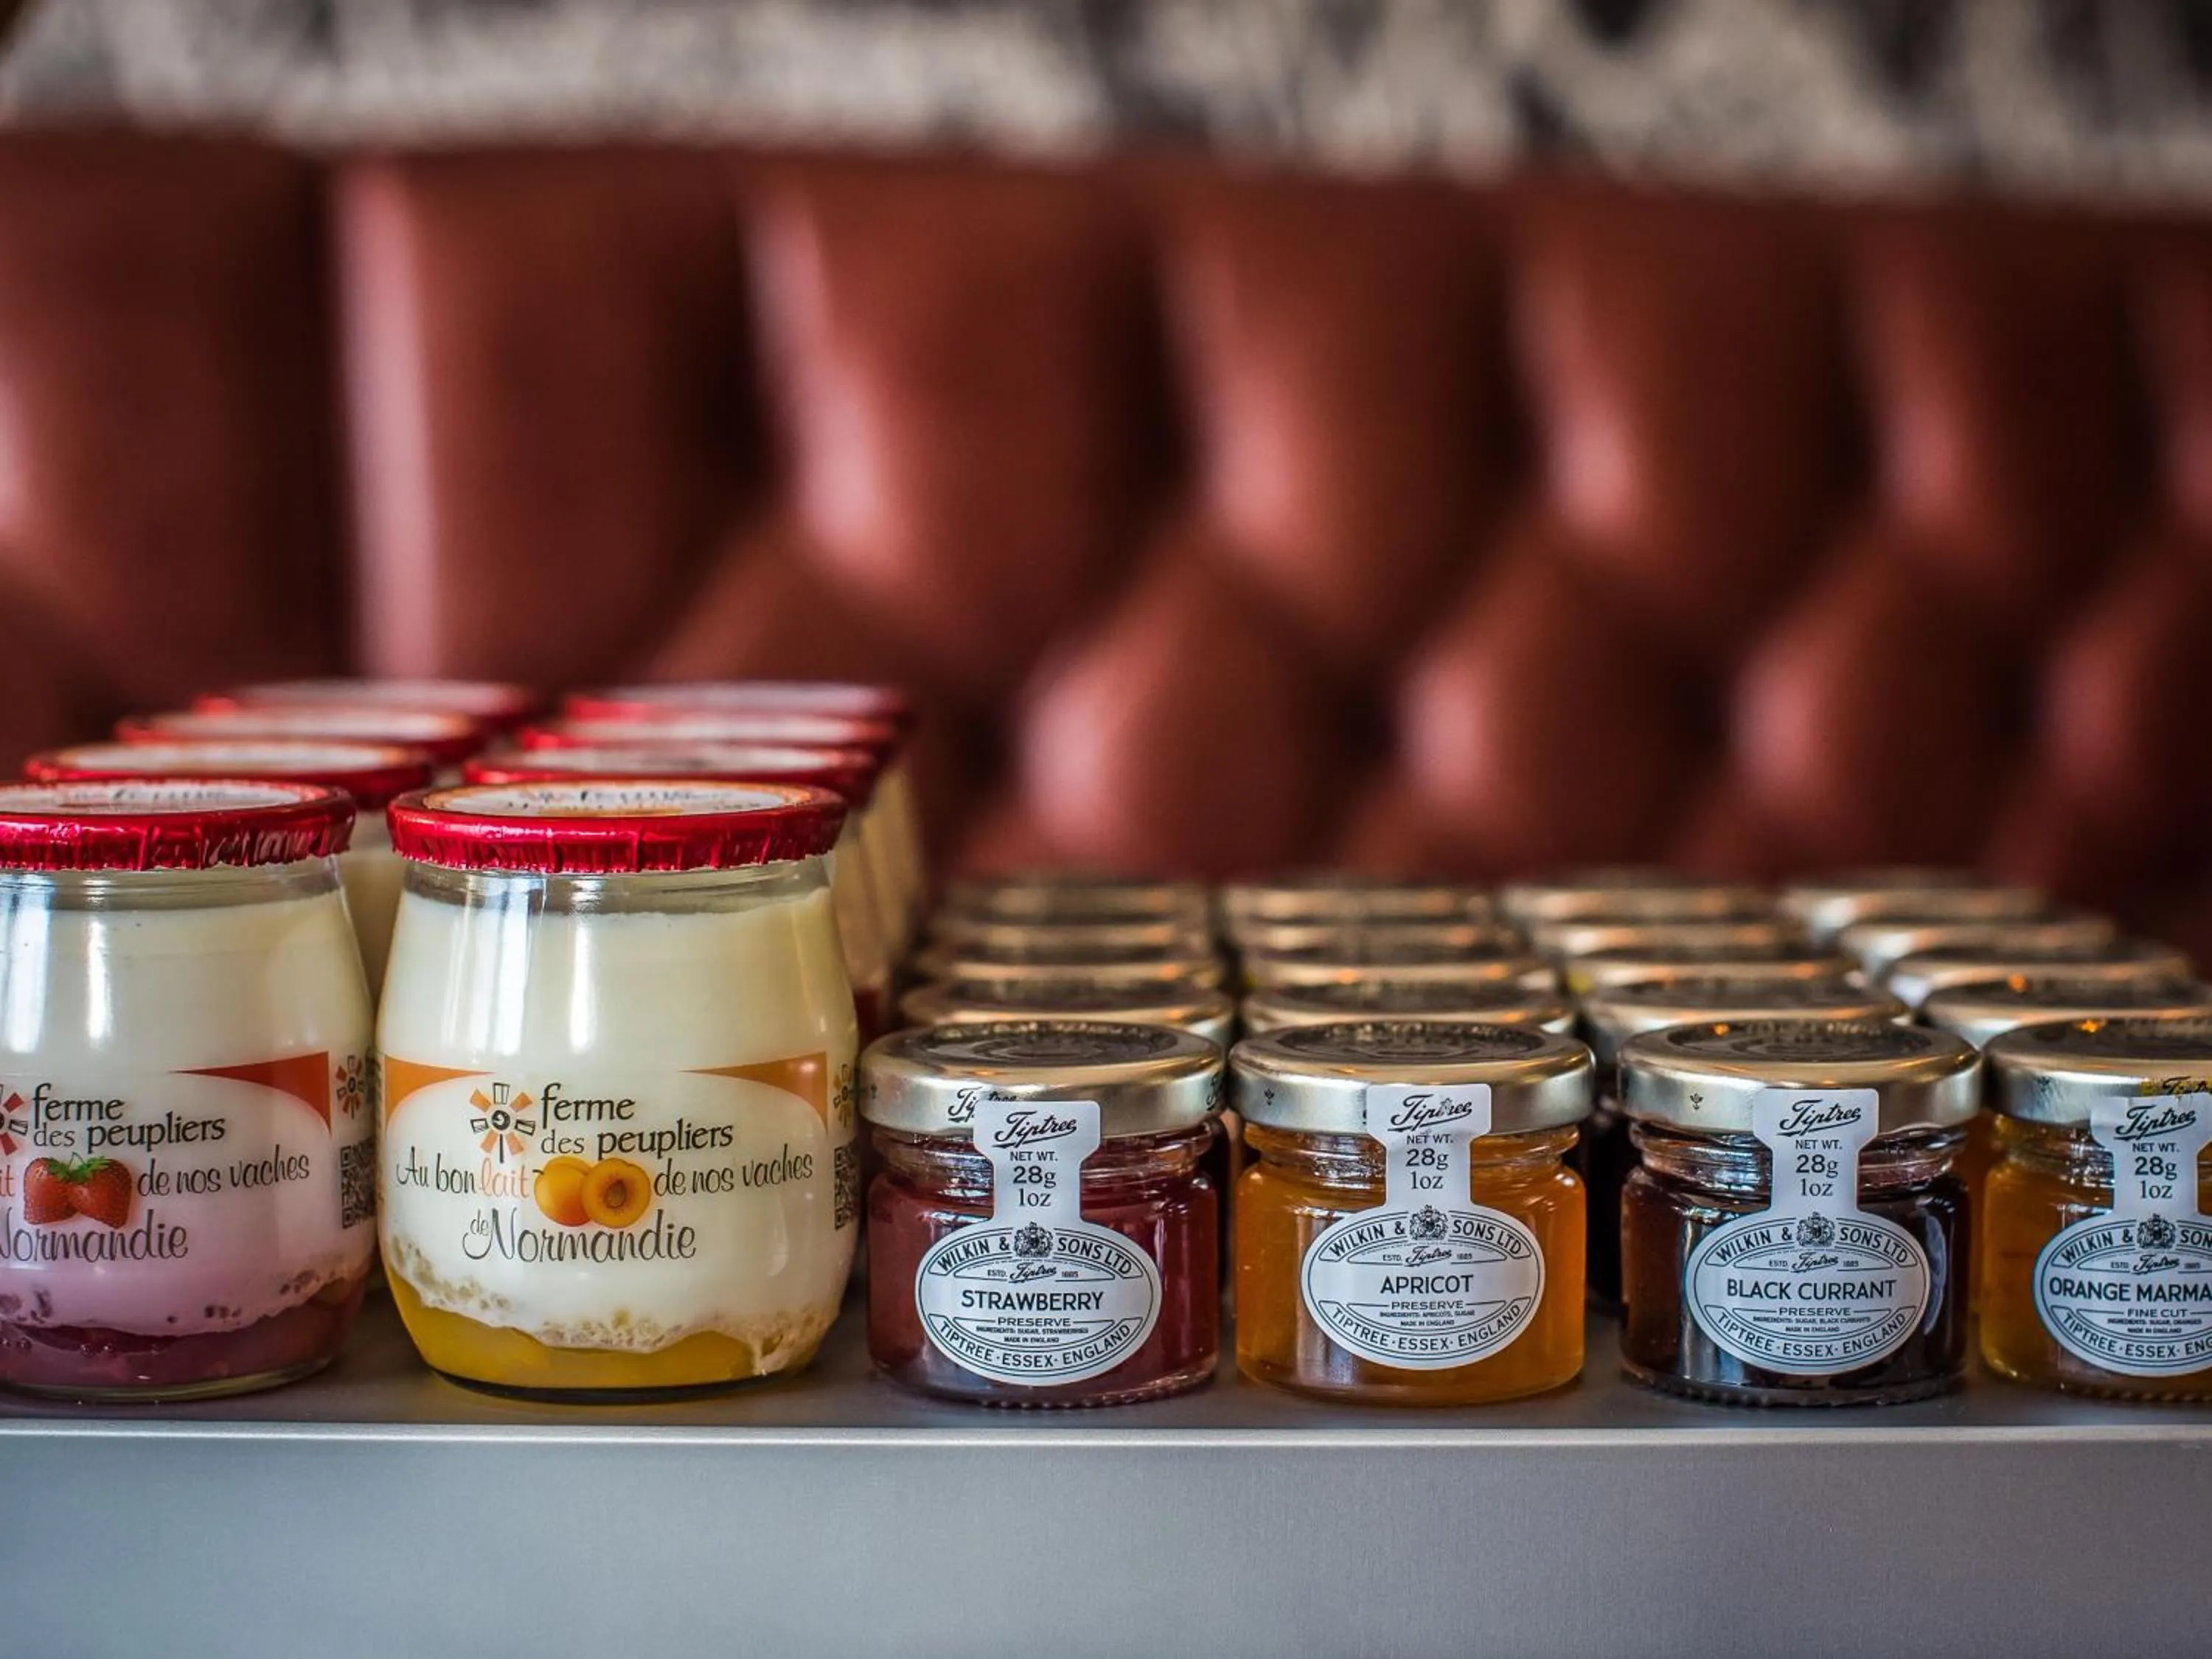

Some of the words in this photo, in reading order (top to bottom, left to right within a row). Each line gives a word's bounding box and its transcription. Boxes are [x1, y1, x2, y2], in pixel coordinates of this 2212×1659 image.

[32, 1082, 125, 1129] ferme
[540, 1082, 636, 1130] ferme
[1776, 1098, 1862, 1137] Tiptree
[33, 1122, 76, 1147] des
[87, 1110, 226, 1153] peupliers
[992, 1110, 1077, 1149] Tiptree
[2113, 1105, 2197, 1141] Tiptree
[540, 1129, 585, 1154] des
[597, 1118, 734, 1160] peupliers
[1406, 1134, 1428, 1144] NET
[1433, 1133, 1453, 1144] WT.
[1795, 1139, 1818, 1150] NET
[1821, 1139, 1843, 1150] WT.
[2132, 1143, 2153, 1152] NET
[2159, 1143, 2180, 1152] WT.
[1009, 1151, 1033, 1162] NET
[1036, 1151, 1058, 1161] WT.
[1405, 1147, 1450, 1170] 28g
[1795, 1154, 1839, 1179] 28g
[2135, 1156, 2177, 1180] 28g
[137, 1158, 170, 1197] de
[176, 1168, 221, 1194] nos
[229, 1144, 310, 1189] vaches
[397, 1145, 429, 1188] Au
[436, 1152, 476, 1194] bon
[480, 1157, 529, 1198] lait
[653, 1158, 686, 1197] de
[692, 1166, 734, 1194] nos
[742, 1143, 813, 1187] vaches
[1012, 1165, 1057, 1189] 28g
[1411, 1170, 1444, 1189] 1oz
[1019, 1188, 1051, 1207] 1oz
[1801, 1178, 1834, 1197] 1oz
[2140, 1180, 2173, 1199] 1oz
[462, 1207, 697, 1263] Normandie
[470, 1209, 490, 1236] de
[1329, 1223, 1385, 1256] WILKIN
[1394, 1221, 1405, 1235] &
[1452, 1220, 1494, 1242] SONS
[1498, 1230, 1522, 1255] LTD
[1716, 1228, 1771, 1262] WILKIN
[1781, 1226, 1792, 1241] &
[1840, 1226, 1881, 1249] SONS
[1884, 1238, 1907, 1263] LTD
[2061, 1231, 2113, 1263] WILKIN
[2122, 1228, 2133, 1242] &
[937, 1237, 990, 1271] WILKIN
[999, 1237, 1009, 1251] &
[1057, 1237, 1102, 1261] SONS
[1105, 1249, 1133, 1275] LTD
[1009, 1262, 1057, 1284] Tiptree
[1380, 1274, 1474, 1294] APRICOT
[961, 1290, 1104, 1311] STRAWBERRY
[1727, 1278, 1792, 1300] BLACK
[1798, 1279, 1897, 1300] CURRANT
[2049, 1276, 2131, 1301] ORANGE
[2136, 1283, 2212, 1302] MARMA
[1391, 1300, 1464, 1310] PRESERVE
[1778, 1307, 1851, 1316] PRESERVE
[2127, 1308, 2157, 1318] FINE
[2160, 1309, 2188, 1318] CUT
[998, 1316, 1071, 1326] PRESERVE
[1332, 1307, 1391, 1346] TIPTREE
[1398, 1337, 1450, 1350] ESSEX
[1458, 1304, 1521, 1347] ENGLAND
[940, 1321, 998, 1362] TIPTREE
[1002, 1353, 1054, 1368] ESSEX
[1062, 1324, 1131, 1365] ENGLAND
[1718, 1312, 1773, 1351] TIPTREE
[1782, 1343, 1834, 1357] ESSEX
[1843, 1313, 1907, 1354] ENGLAND
[2064, 1312, 2117, 1352] TIPTREE
[2125, 1343, 2177, 1358] ESSEX
[2185, 1337, 2212, 1355] ENG
